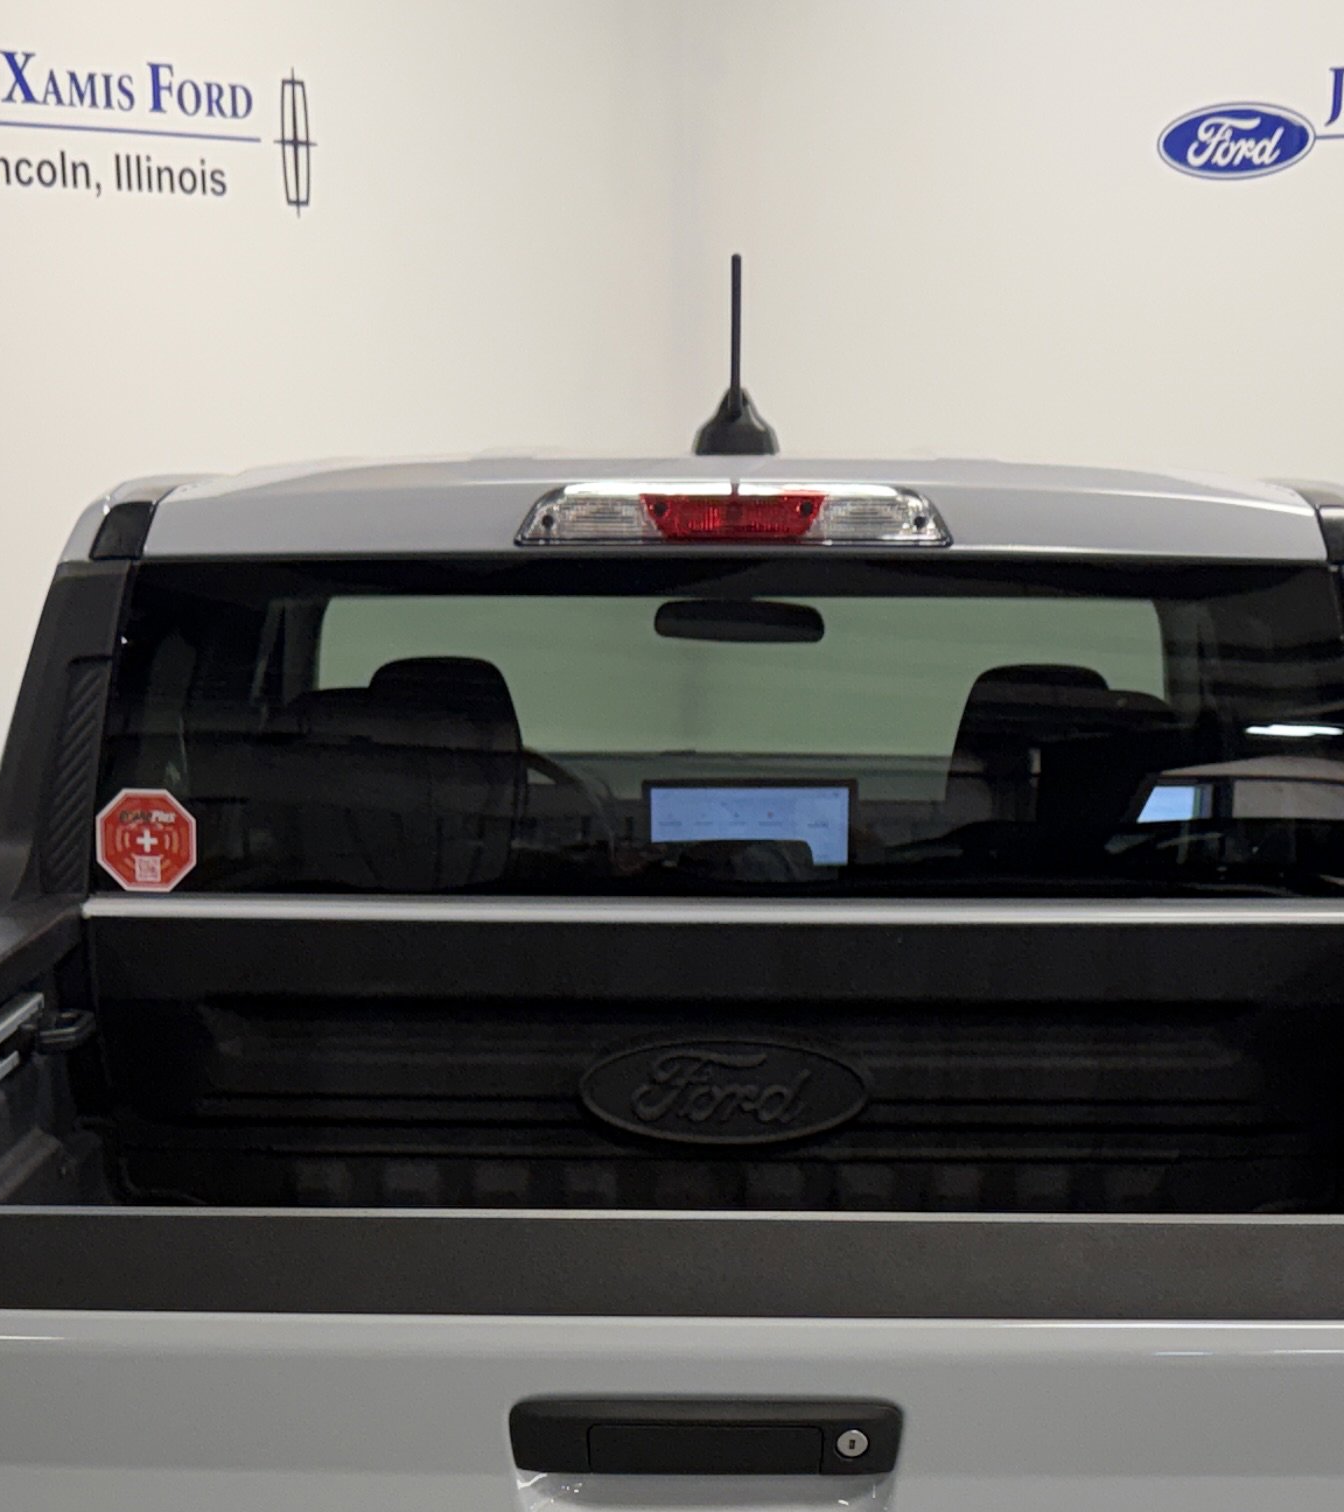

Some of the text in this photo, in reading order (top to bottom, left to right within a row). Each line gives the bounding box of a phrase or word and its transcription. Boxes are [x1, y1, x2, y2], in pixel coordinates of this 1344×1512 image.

[0, 50, 135, 113] XAMIS
[147, 62, 254, 120] FORD
[1186, 116, 1282, 169] Ford
[115, 153, 228, 197] Illinois
[632, 1050, 811, 1122] Ford
